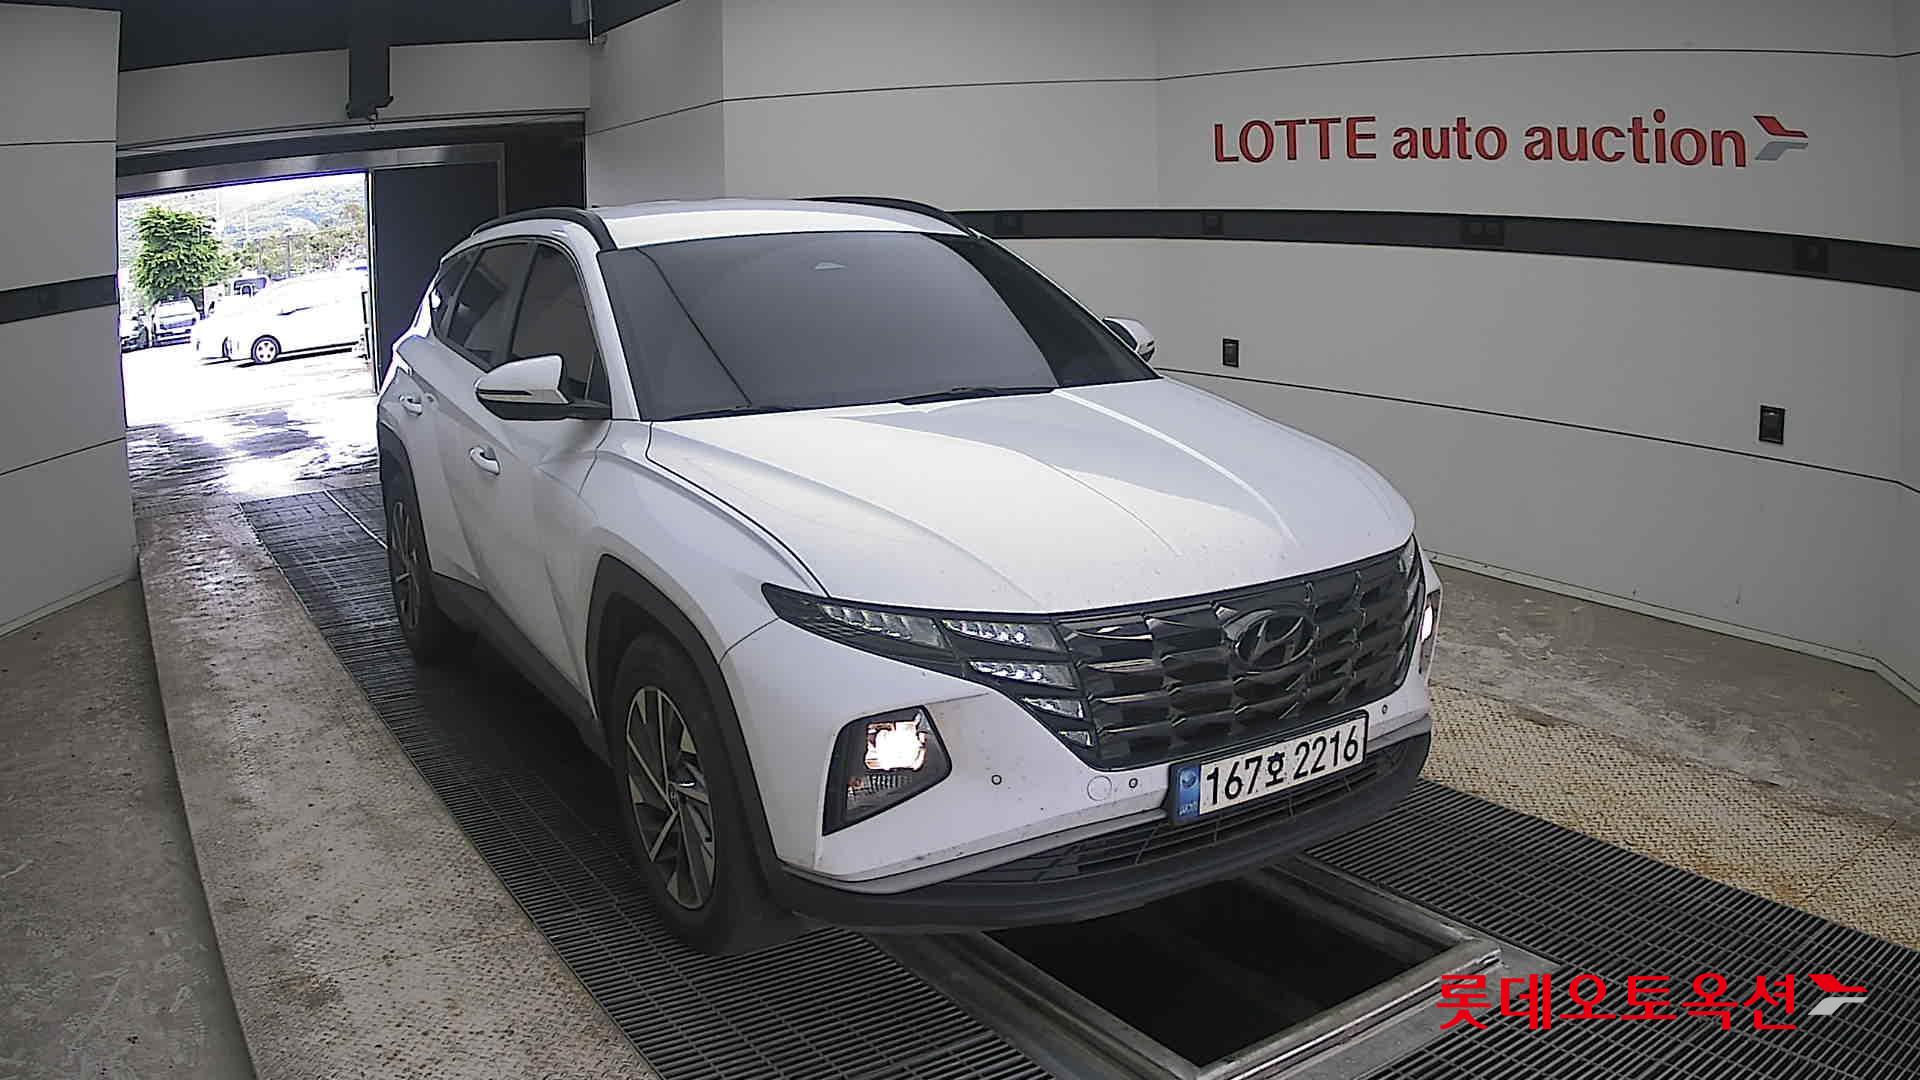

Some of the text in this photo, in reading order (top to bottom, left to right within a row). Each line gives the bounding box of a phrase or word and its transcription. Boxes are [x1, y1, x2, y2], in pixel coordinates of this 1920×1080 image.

[1213, 109, 1748, 168] LOTTE auto auction
